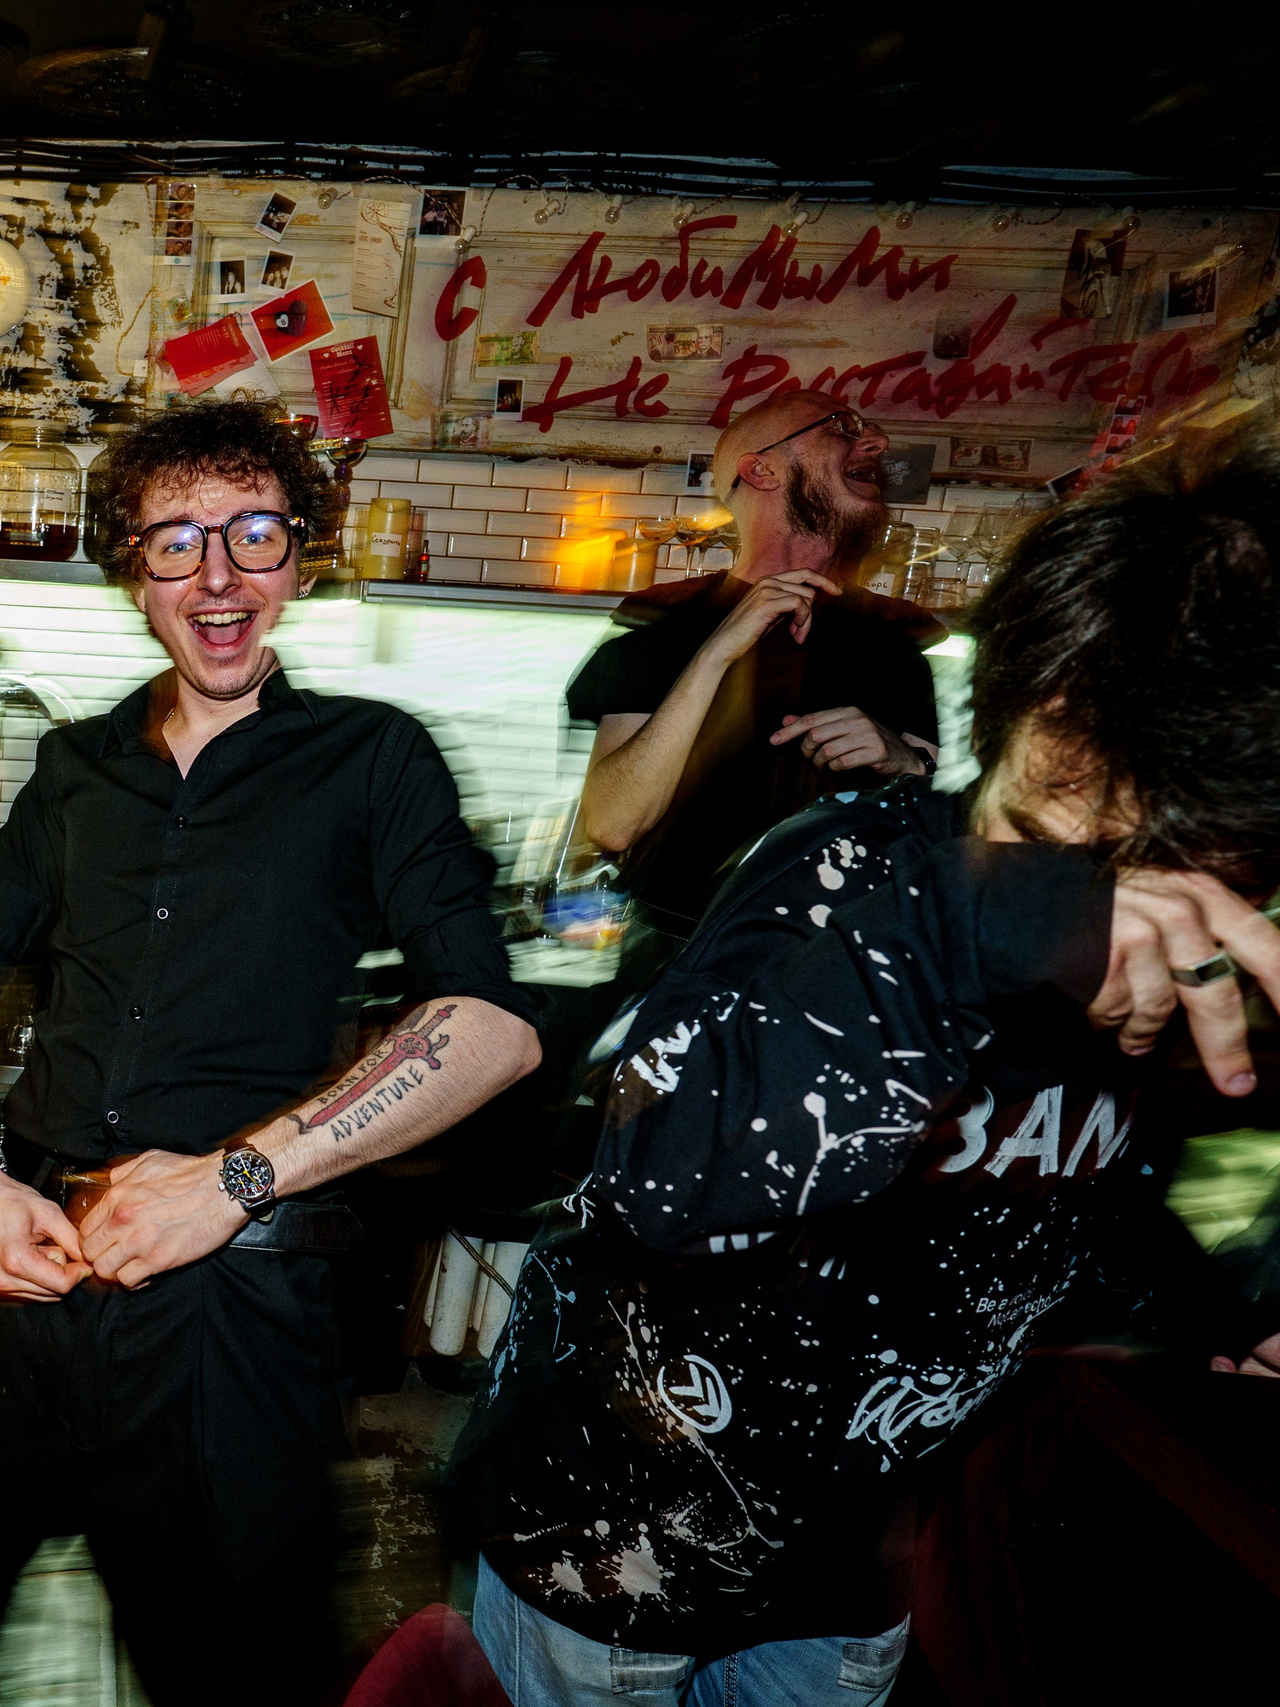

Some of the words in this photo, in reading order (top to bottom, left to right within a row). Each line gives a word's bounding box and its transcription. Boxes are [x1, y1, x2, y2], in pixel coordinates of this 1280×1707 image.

[330, 343, 355, 353] Cocktail
[336, 350, 353, 358] Menu
[521, 355, 670, 433] Не
[319, 1075, 360, 1105] BORN
[359, 1049, 390, 1080] FOR
[329, 1065, 424, 1143] ADVENTURE
[976, 1297, 997, 1313] Be
[998, 1298, 1008, 1310] a
[1024, 1293, 1052, 1314] echo
